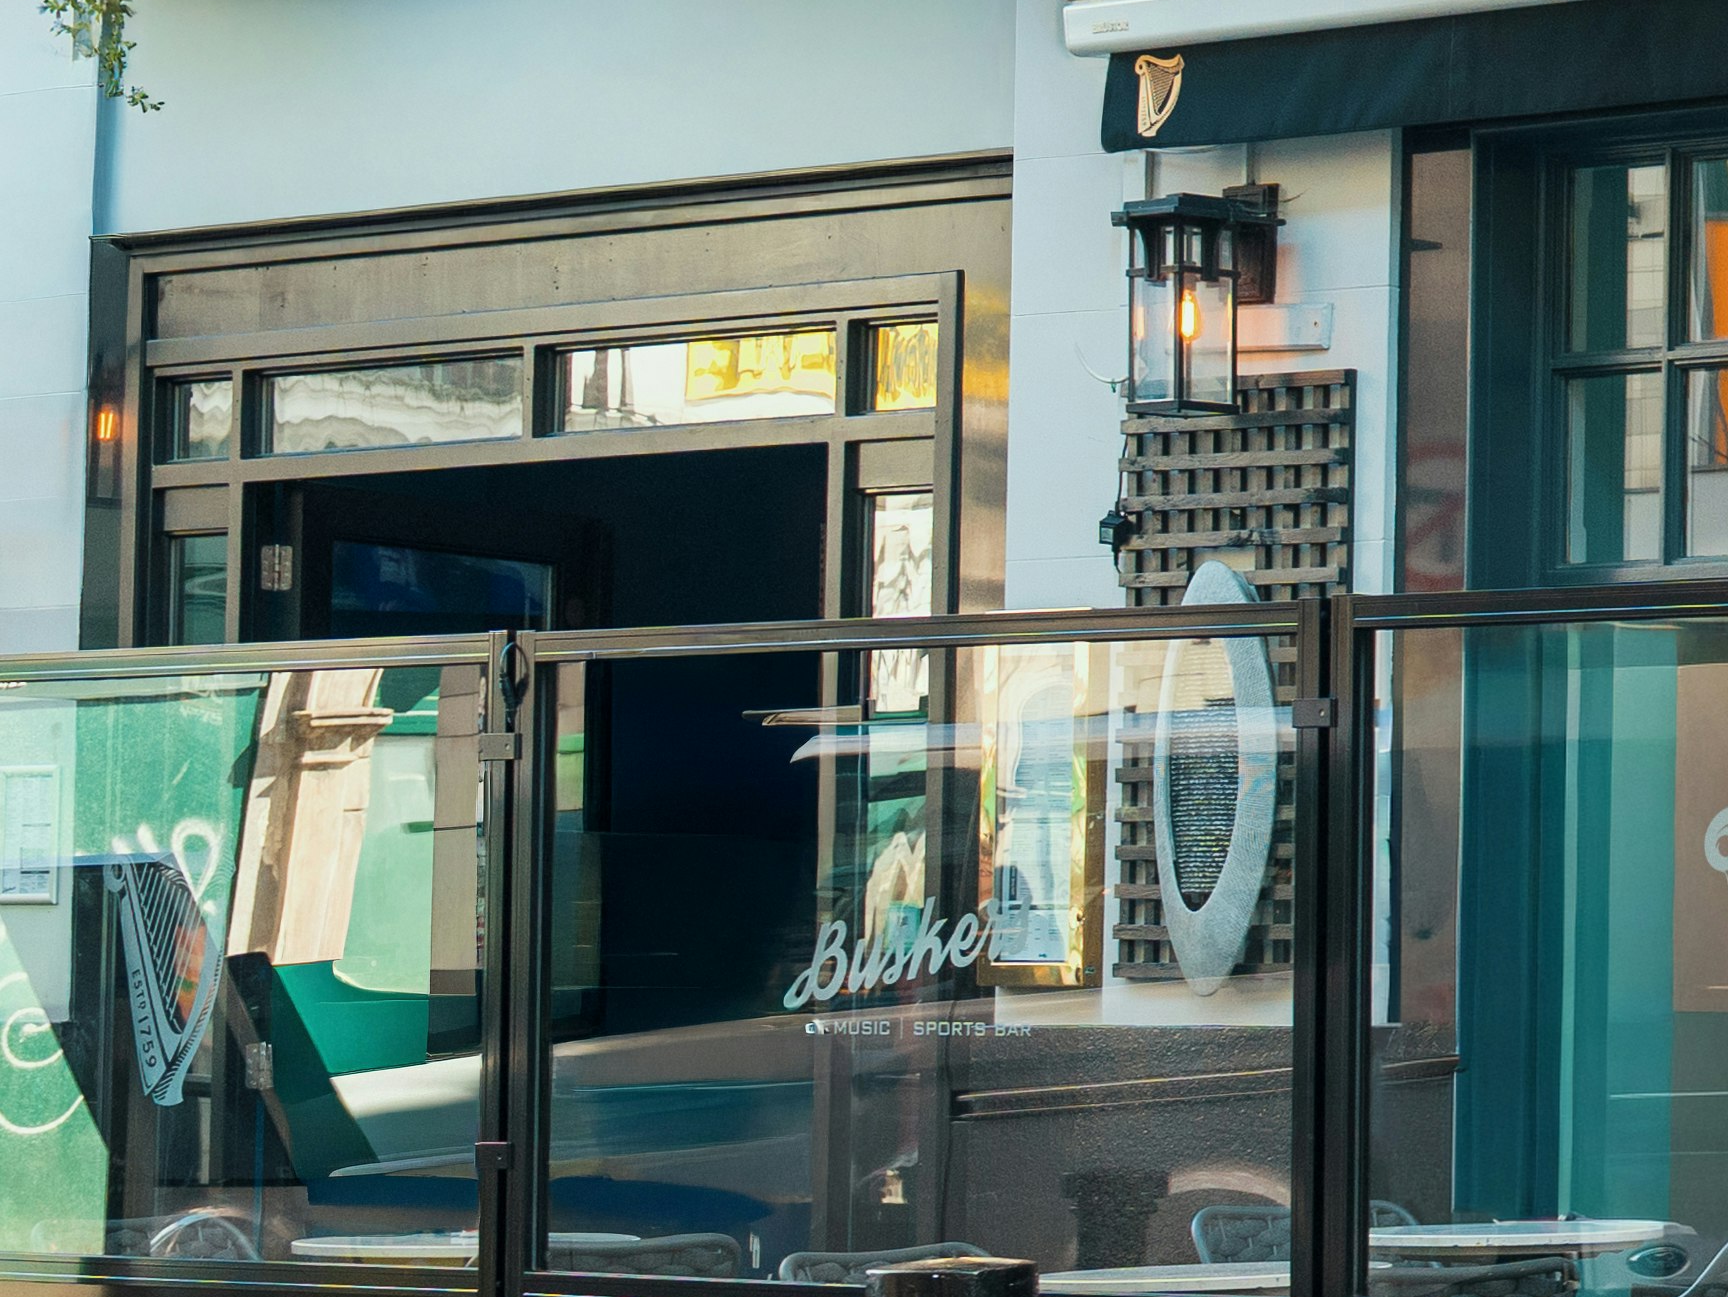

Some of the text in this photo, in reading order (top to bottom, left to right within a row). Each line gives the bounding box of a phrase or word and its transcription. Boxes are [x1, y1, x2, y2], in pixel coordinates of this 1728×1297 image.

[783, 896, 1032, 1010] Buskers
[138, 1015, 157, 1068] 1759
[833, 1021, 890, 1036] MUSIC
[913, 1021, 986, 1037] SPORTS
[995, 1022, 1032, 1037] BAR
